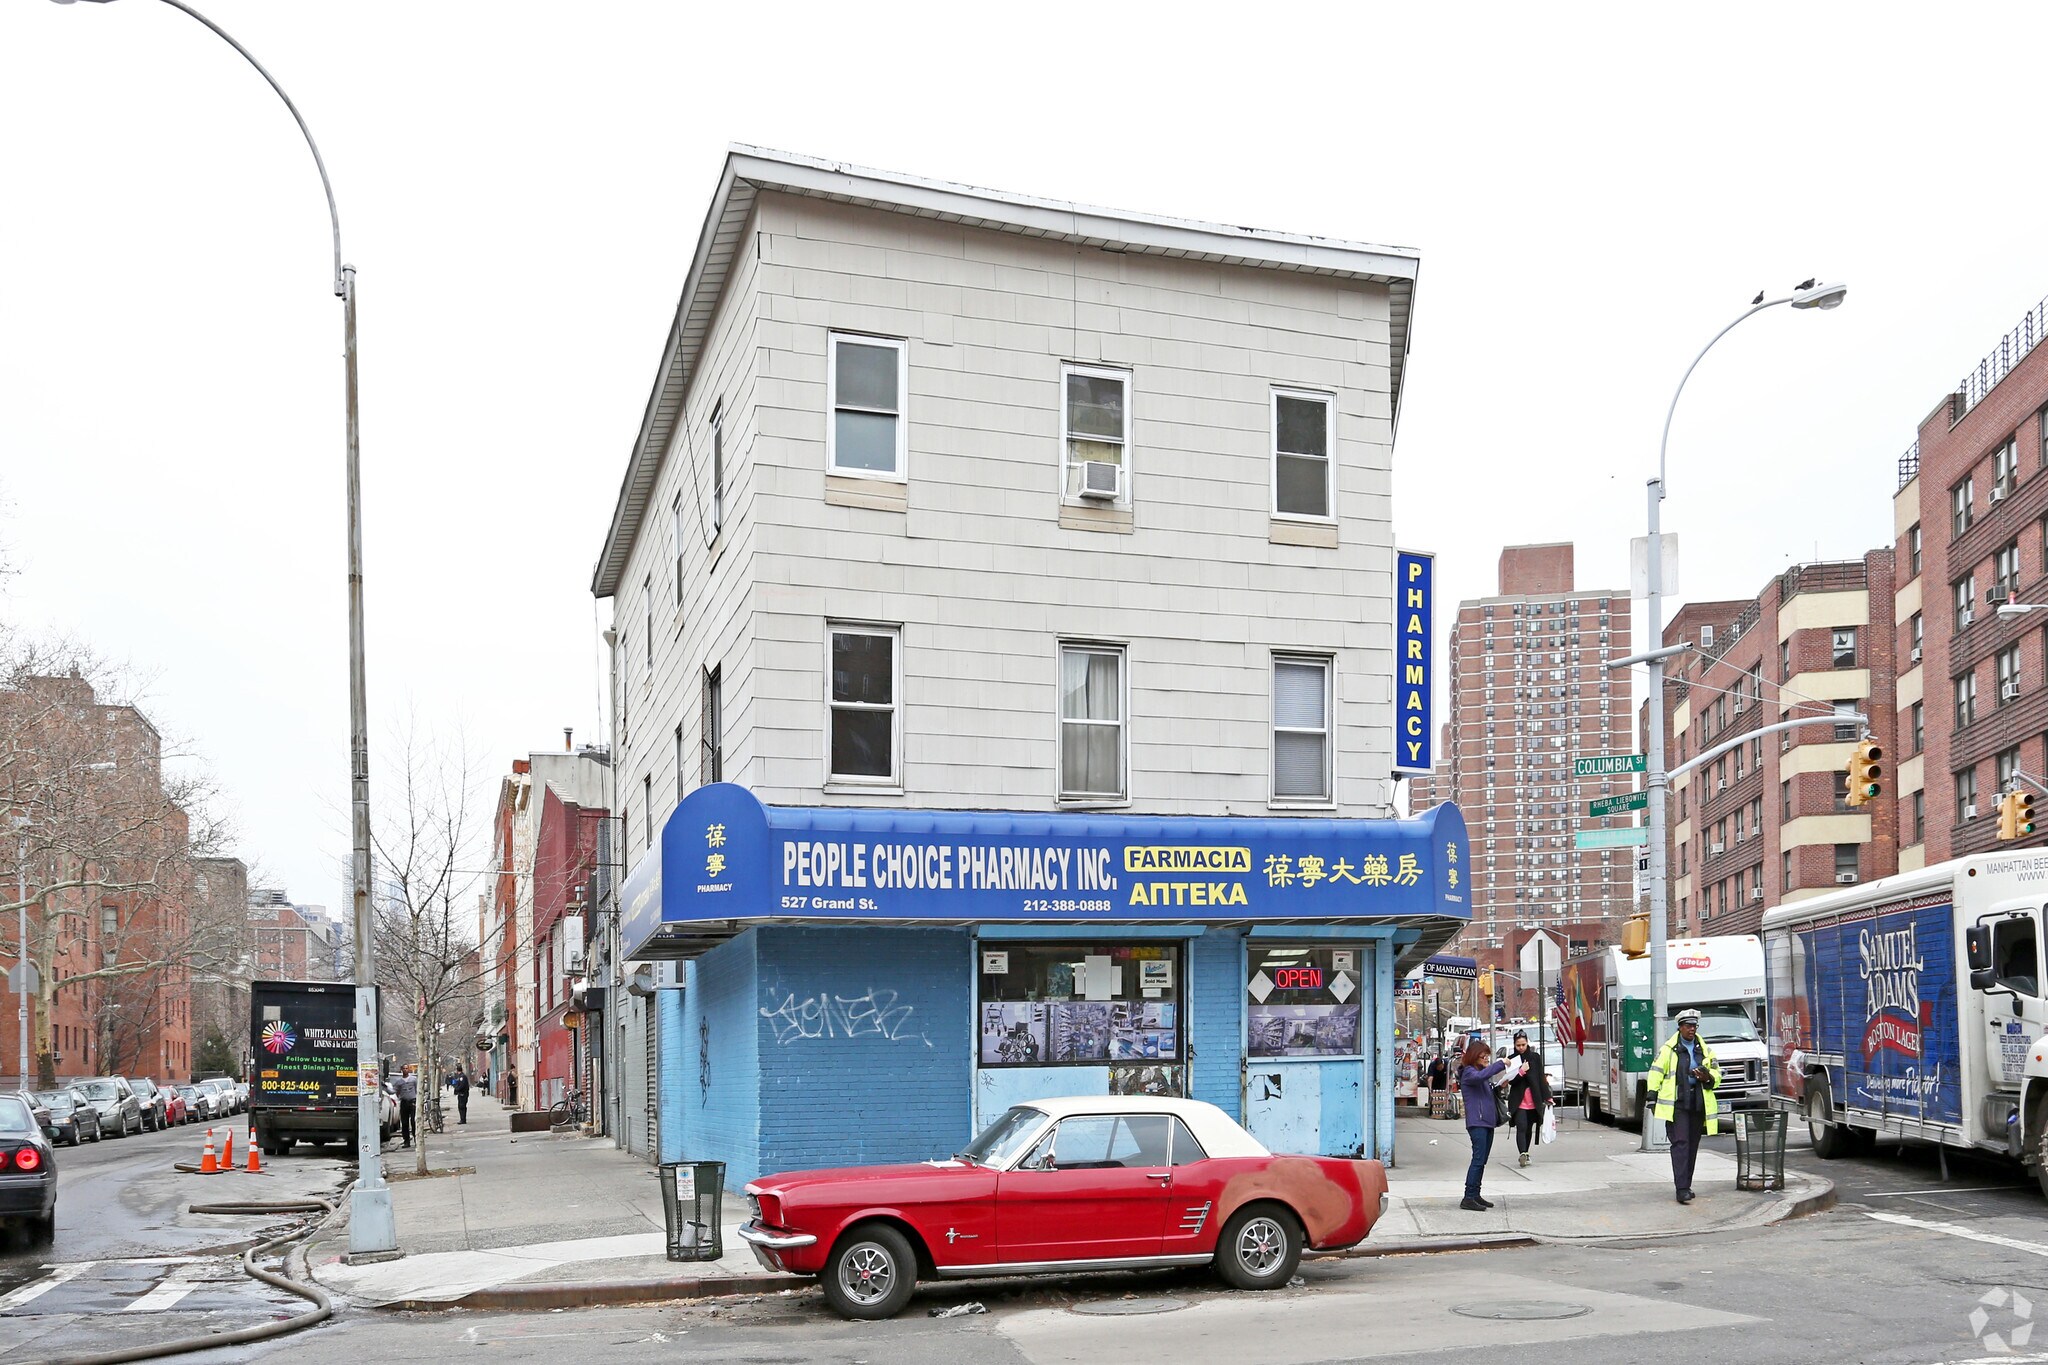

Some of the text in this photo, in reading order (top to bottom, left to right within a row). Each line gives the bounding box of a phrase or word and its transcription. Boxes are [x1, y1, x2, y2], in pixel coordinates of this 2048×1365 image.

[1406, 562, 1423, 761] PHARMACY
[1578, 756, 1644, 774] COLUMBIA ST
[1593, 793, 1647, 808] RHEBA LIEBOWITZ
[1607, 804, 1630, 813] SQUARE
[784, 842, 1118, 892] PEOPLE CHOICE PHARMACY INC.
[1129, 850, 1246, 868] FARMACIA
[1986, 857, 2048, 874] MANHATTAN BEE
[697, 883, 732, 892] PHARMACY
[1128, 882, 1248, 906] АПТЕКА
[781, 896, 878, 910] 527 Grand St.
[1023, 900, 1111, 912] 212-388-0888
[1860, 922, 1923, 980] SAMUEL
[1426, 964, 1436, 972] OF
[1436, 965, 1476, 976] MANHATTAN
[1276, 969, 1322, 988] OPEN
[1866, 972, 1920, 1023] ADAMS
[304, 1028, 358, 1039] WHITE PLAINS LIN
[1868, 1024, 1894, 1054] BOSTON
[342, 1040, 358, 1048] CARTE
[262, 1080, 320, 1090] 800-825-4646
[1892, 1078, 1905, 1090] more
